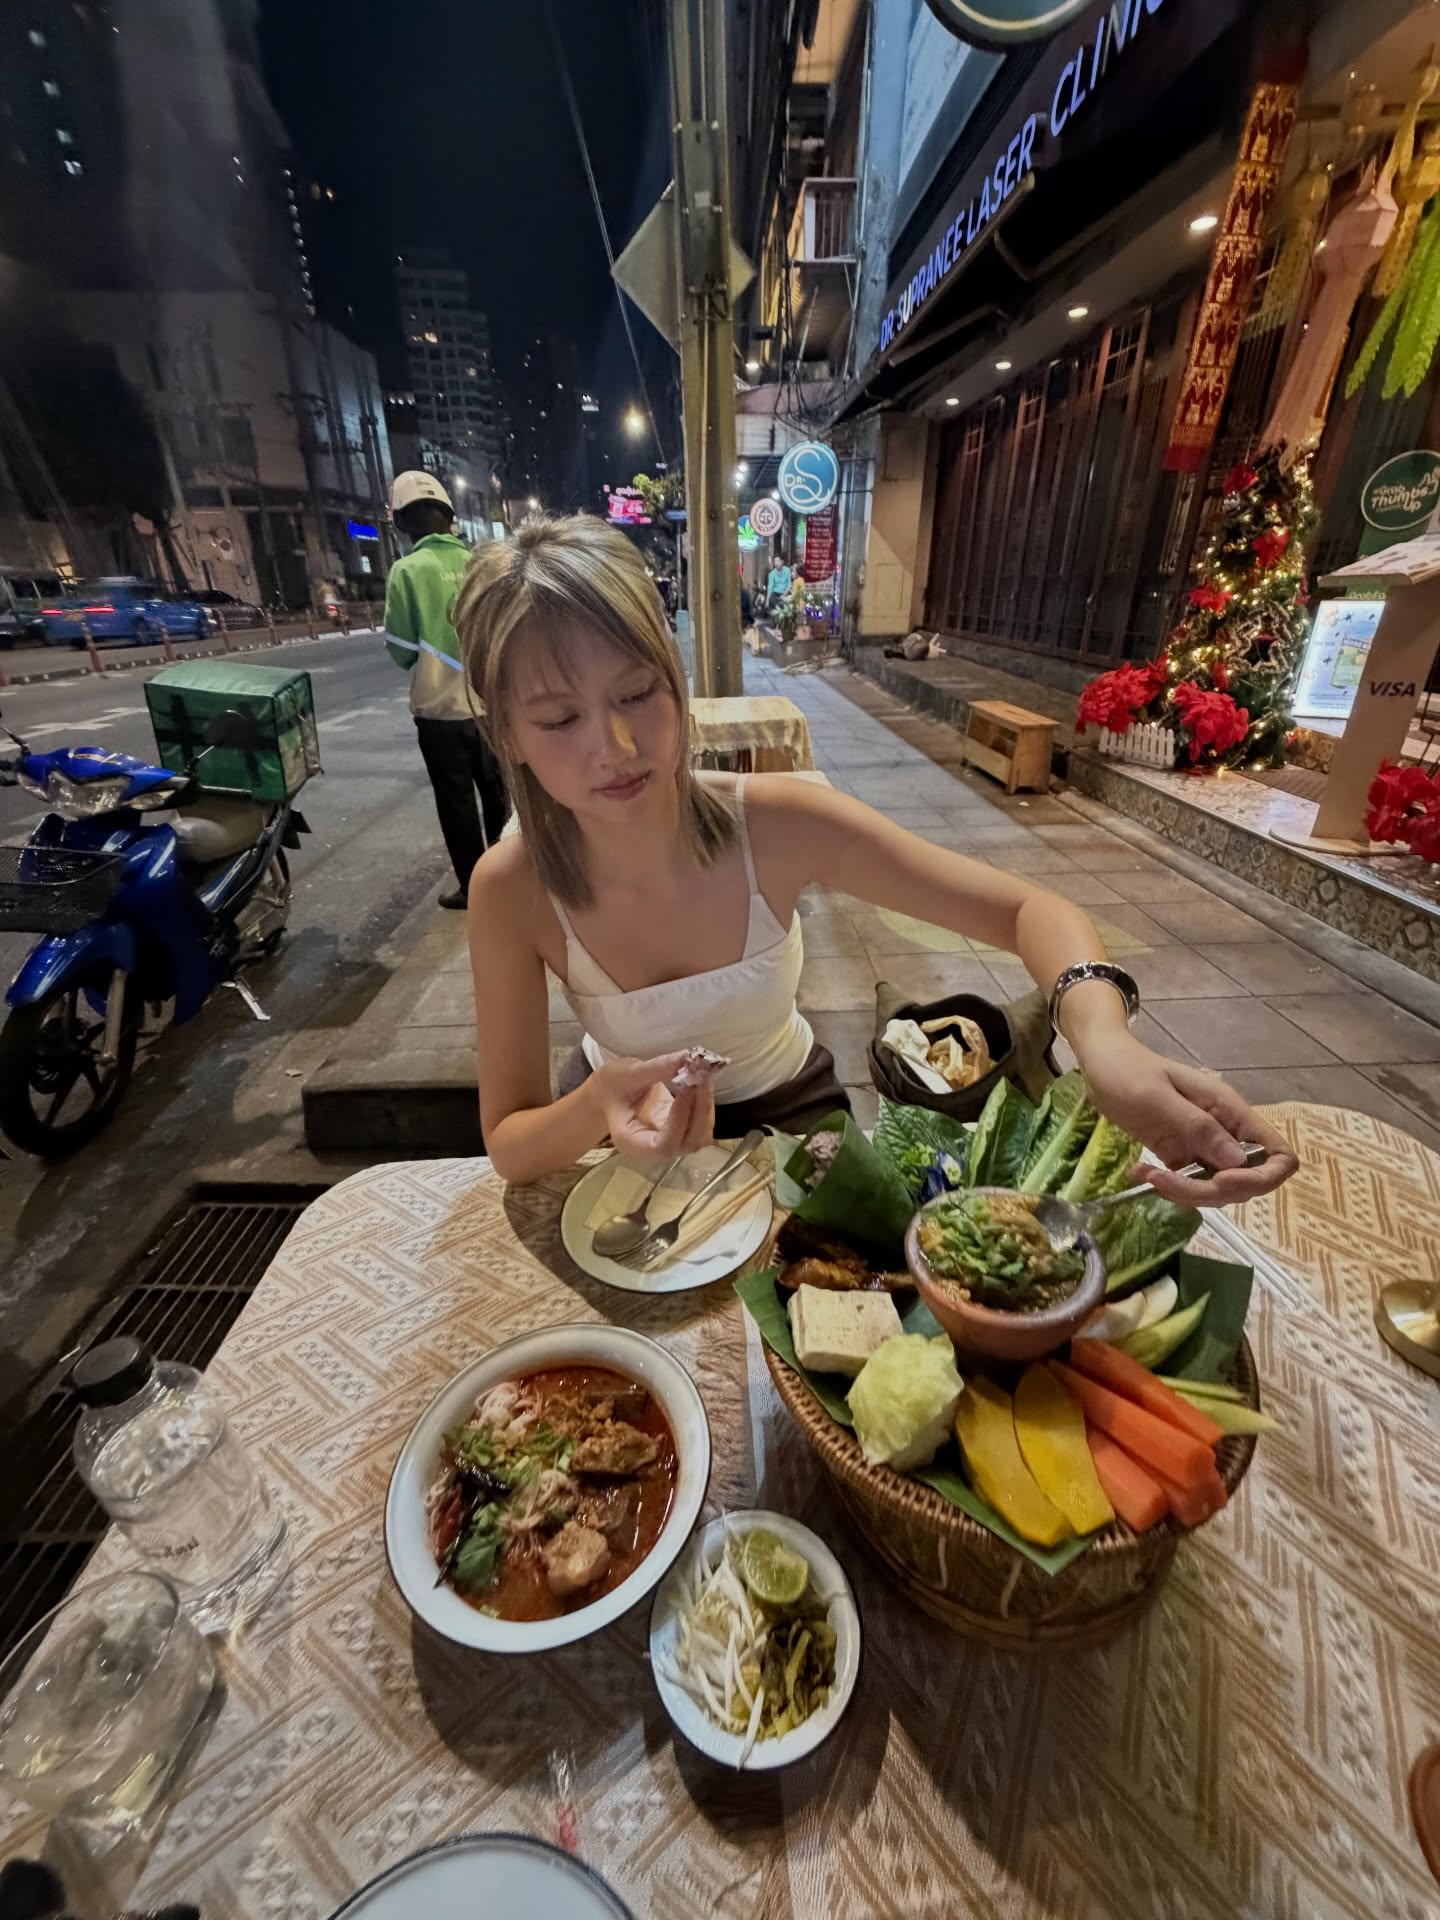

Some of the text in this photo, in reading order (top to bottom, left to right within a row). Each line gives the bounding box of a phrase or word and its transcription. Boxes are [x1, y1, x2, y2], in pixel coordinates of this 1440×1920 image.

[897, 209, 965, 331] SUPRANEE
[966, 113, 1037, 244] LASER
[1050, 0, 1165, 137] CLIN
[1369, 680, 1416, 697] VISA
